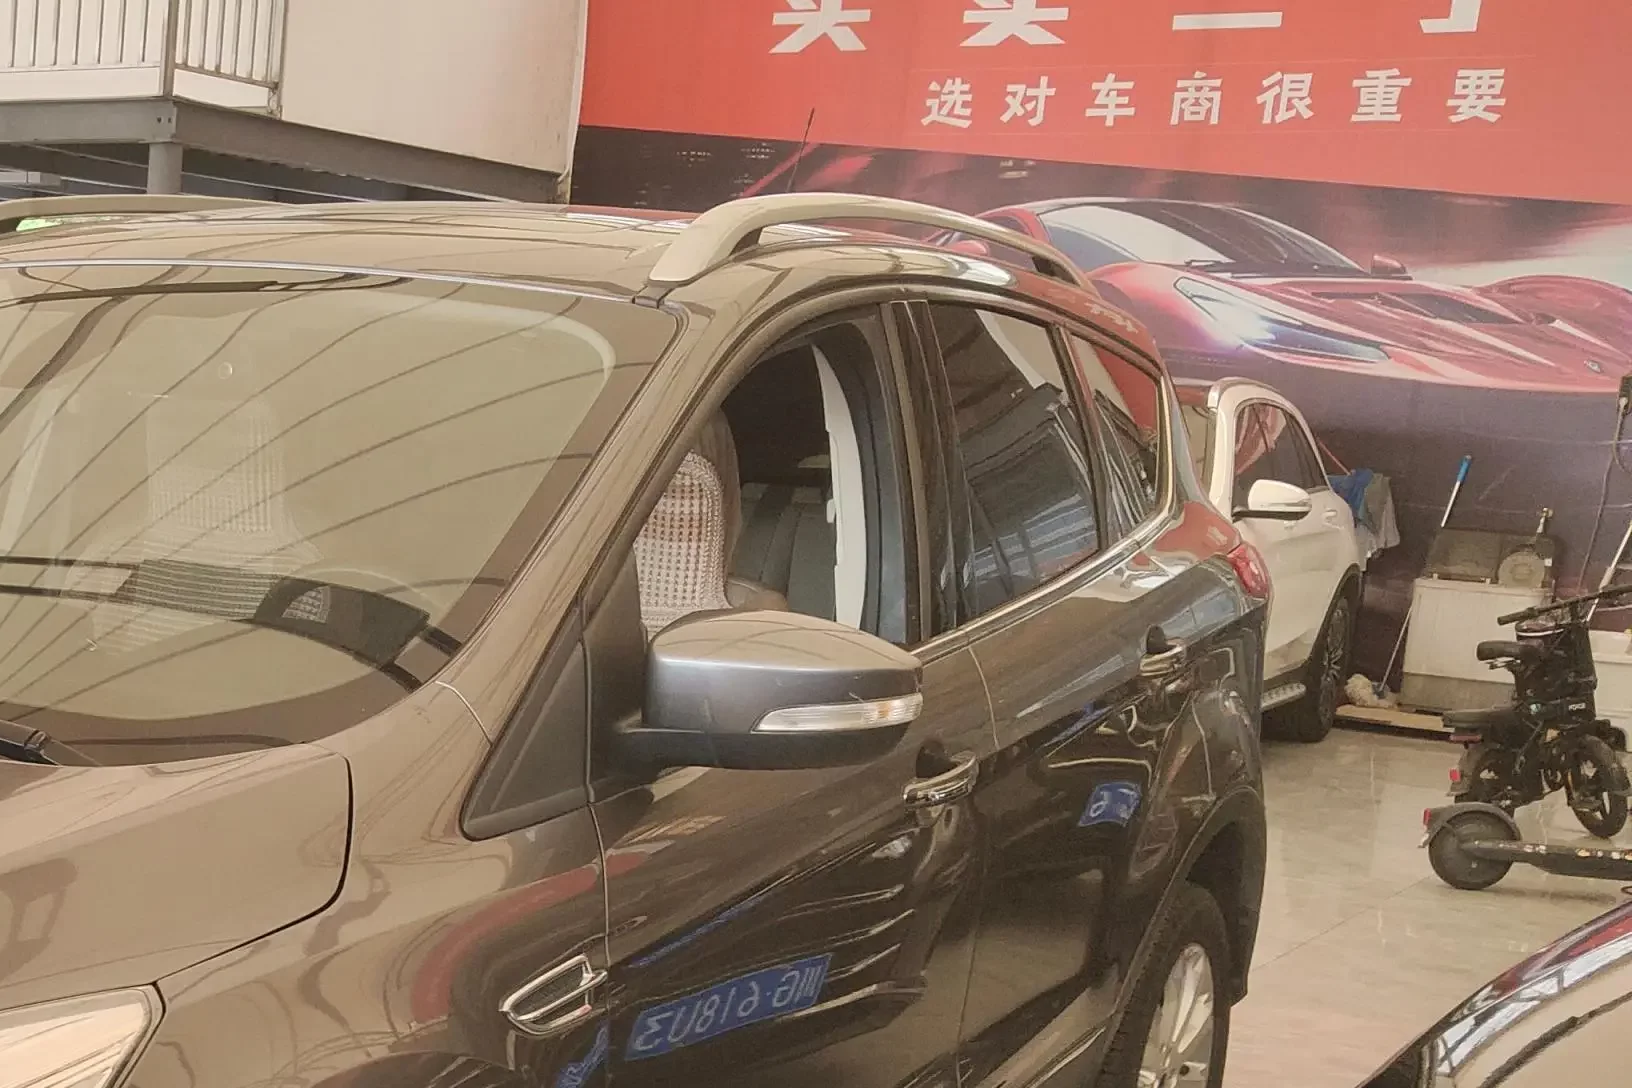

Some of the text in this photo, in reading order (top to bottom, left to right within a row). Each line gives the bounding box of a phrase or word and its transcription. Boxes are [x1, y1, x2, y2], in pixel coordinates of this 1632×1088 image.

[920, 68, 1507, 128] 选对车商很重要
